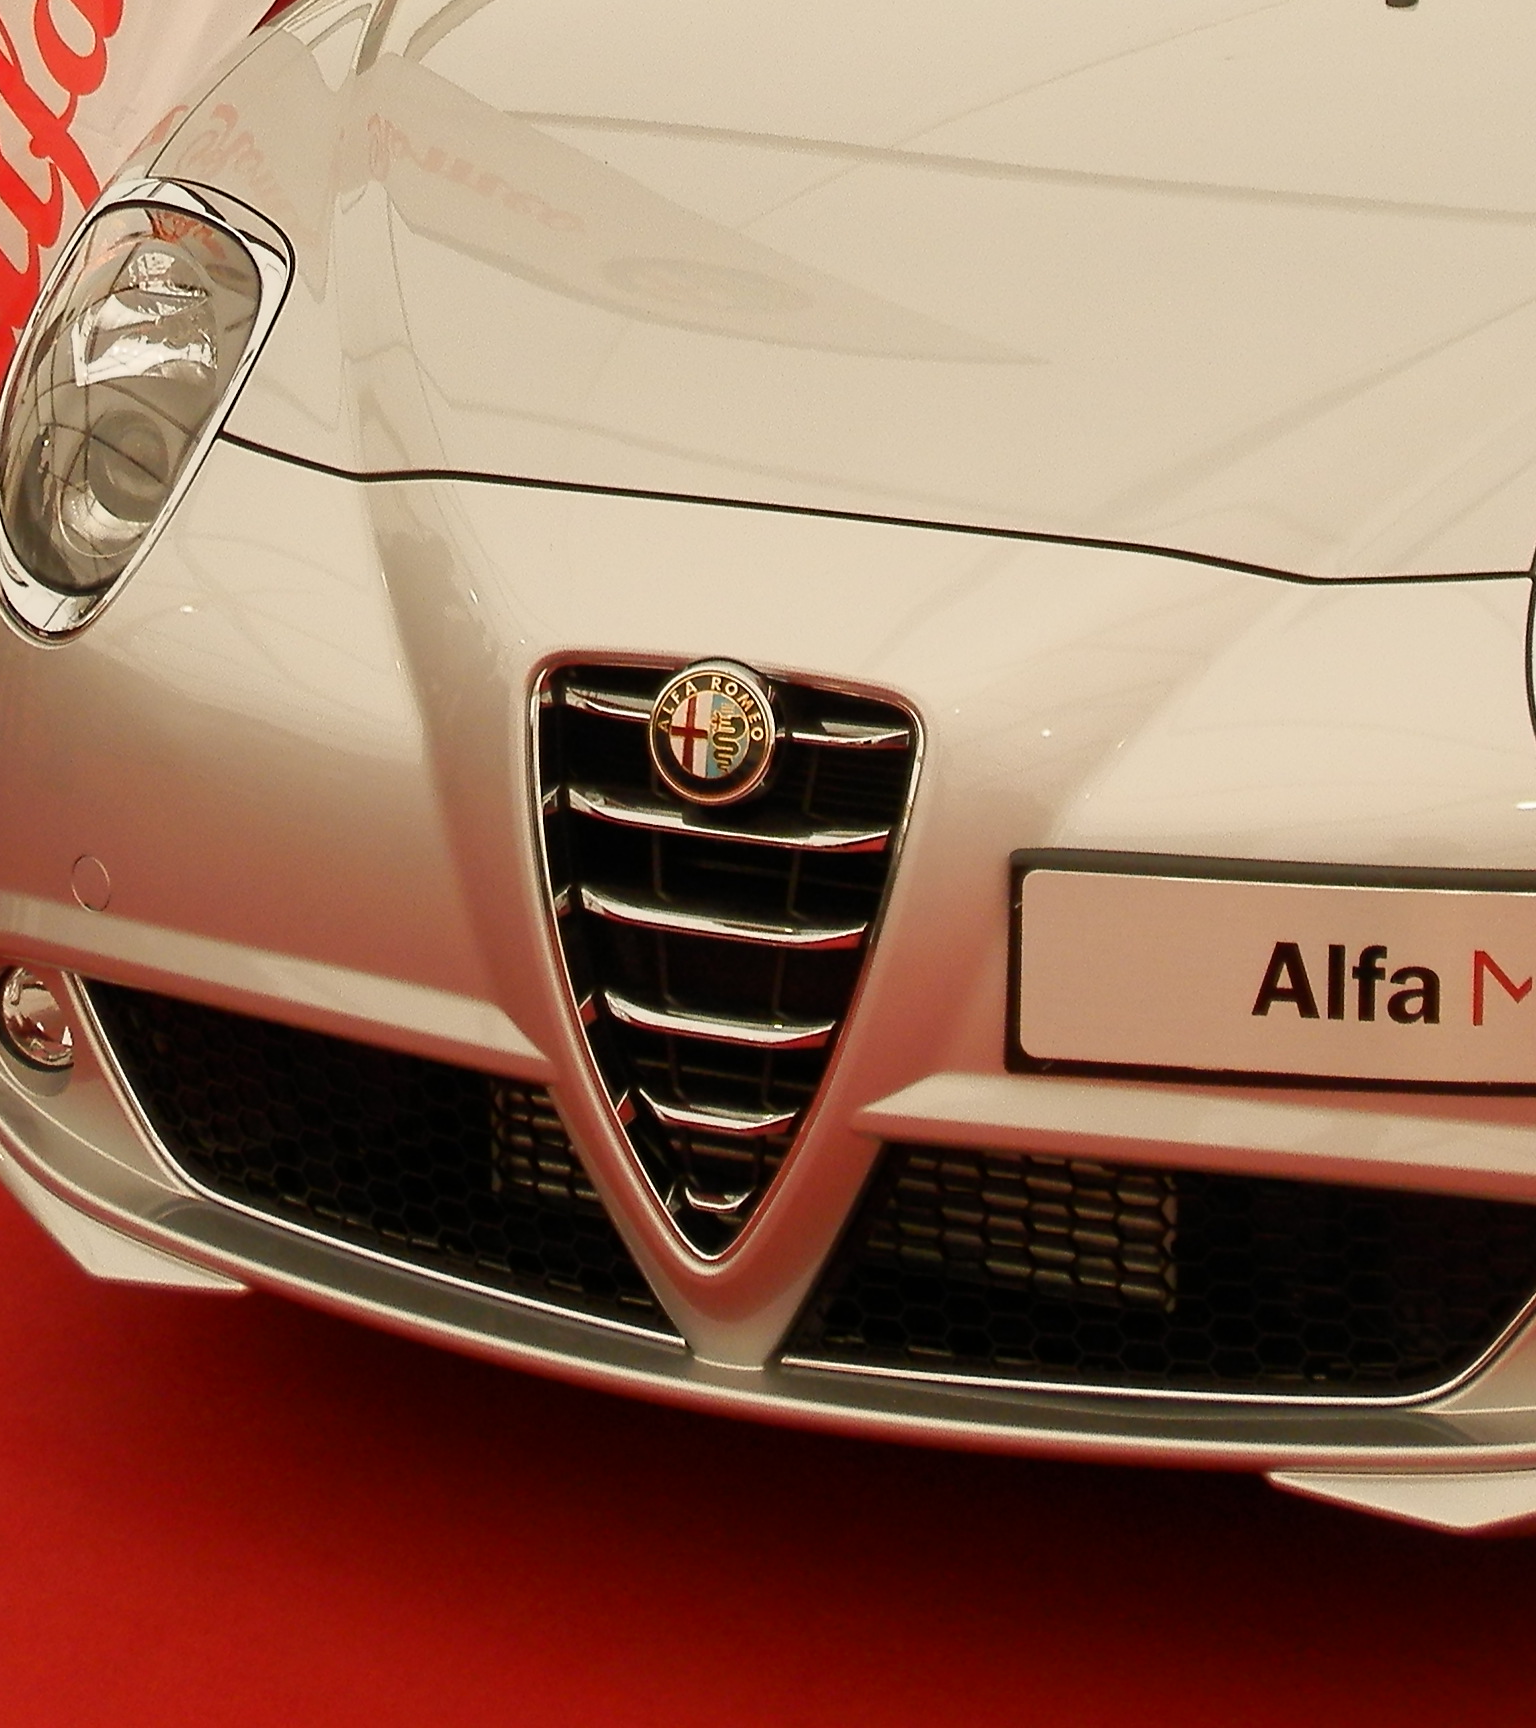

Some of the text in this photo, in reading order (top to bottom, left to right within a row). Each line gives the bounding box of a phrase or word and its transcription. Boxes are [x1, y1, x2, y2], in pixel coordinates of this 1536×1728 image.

[658, 676, 765, 741] ALFA ROMEO
[1252, 941, 1443, 1025] Alfa
